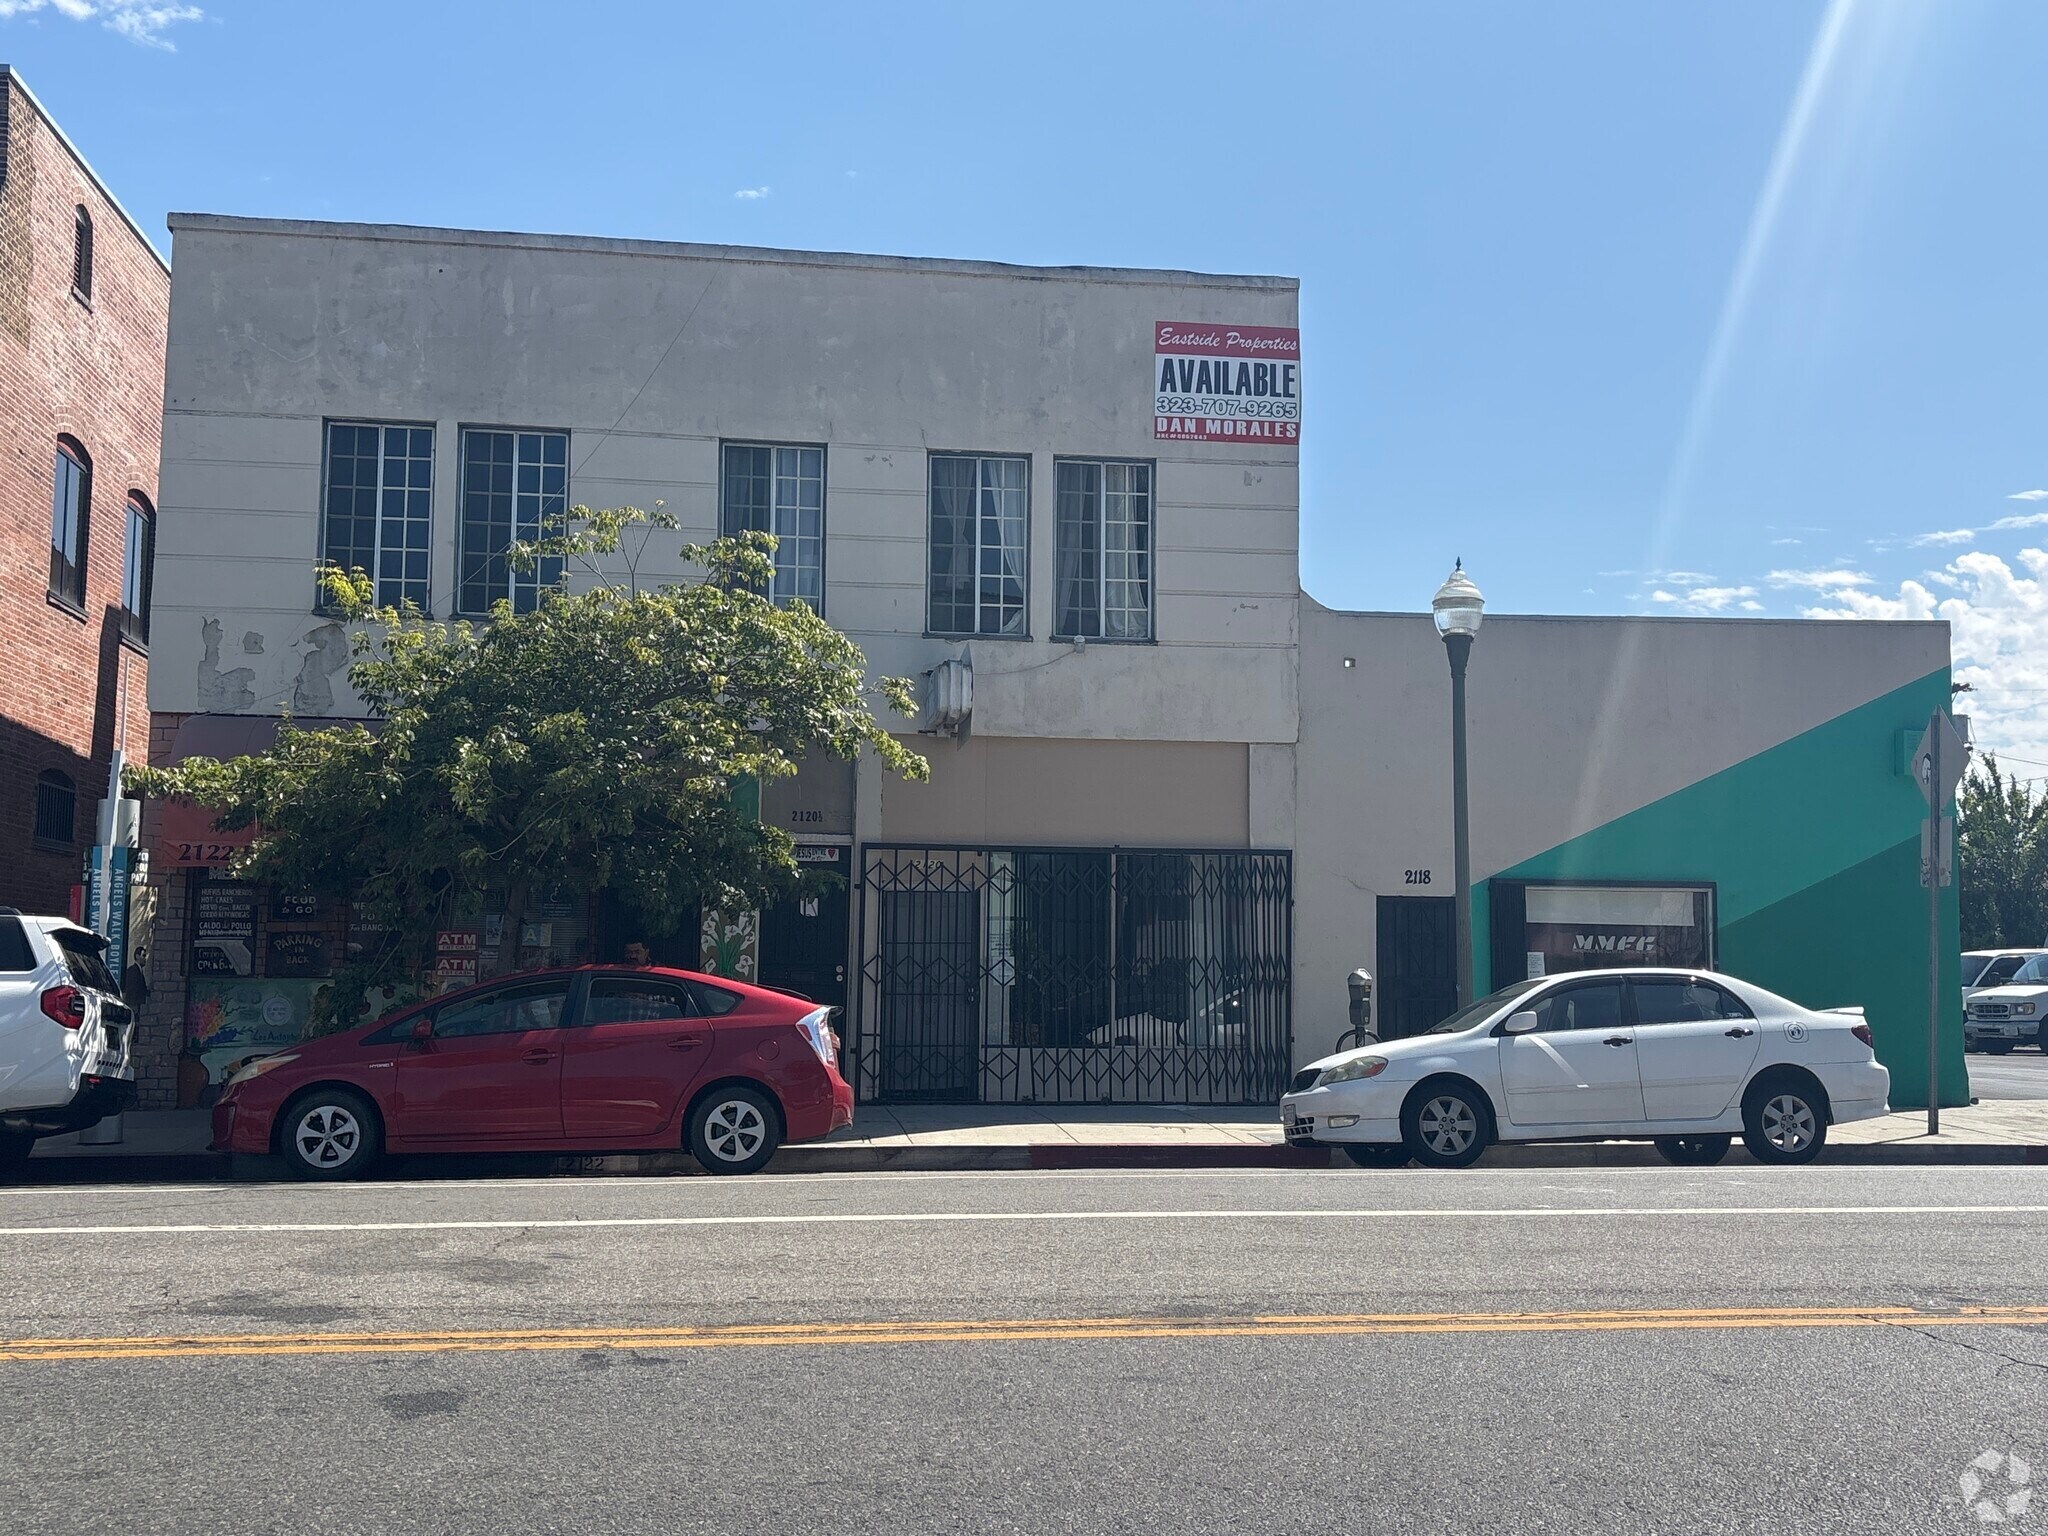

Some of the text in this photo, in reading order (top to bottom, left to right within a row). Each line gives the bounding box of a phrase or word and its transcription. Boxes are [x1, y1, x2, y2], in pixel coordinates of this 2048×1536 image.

[1158, 327, 1297, 352] Eastside Properties
[1159, 358, 1296, 398] AVAILABLE
[1157, 396, 1297, 418] 323-707-9265
[1157, 417, 1297, 438] DAN MORALES
[178, 843, 234, 861] 2122
[1404, 869, 1431, 885] 2118
[215, 896, 234, 904] CAKES
[284, 896, 317, 904] FOOD
[295, 906, 313, 914] GO
[109, 868, 124, 975] ANGELS WALK BOYLE
[199, 921, 221, 930] CALDO
[231, 921, 252, 930] POLLO
[438, 933, 476, 945] ATM
[525, 928, 537, 941] A
[273, 934, 323, 951] PARKING
[286, 955, 310, 965] BACK
[437, 959, 476, 970] ATM
